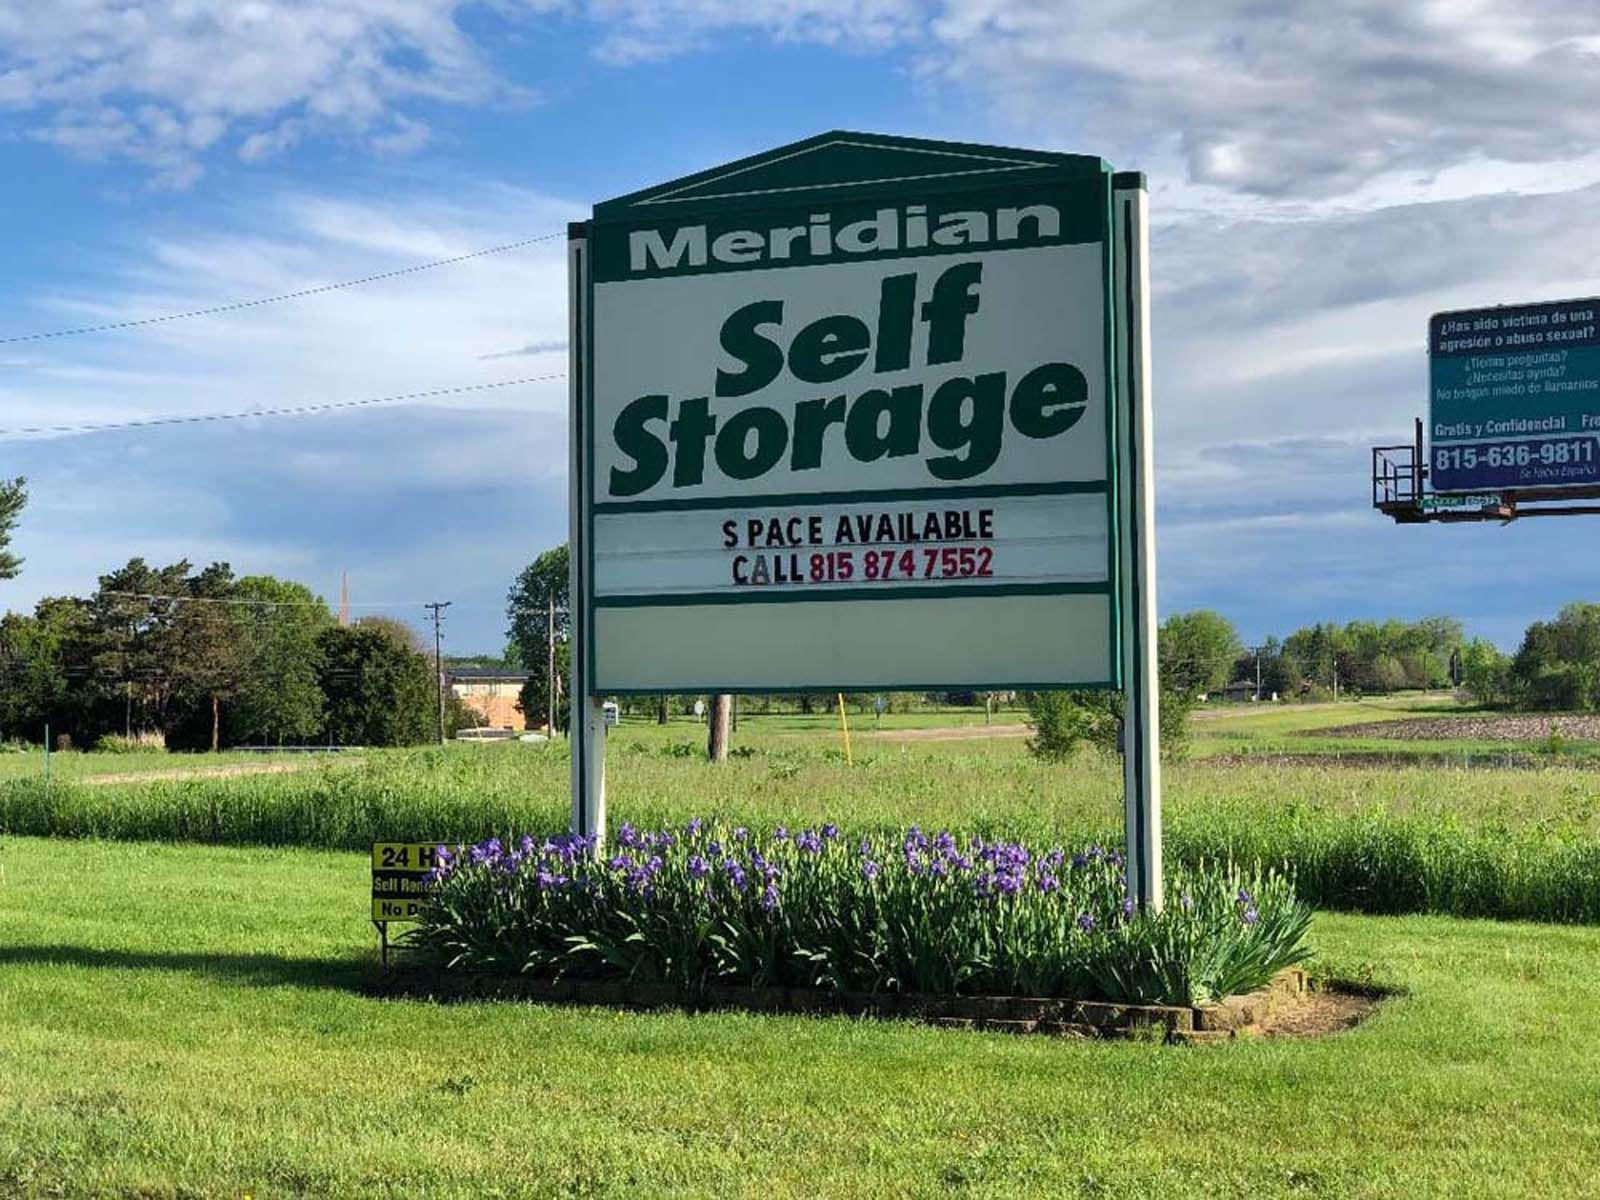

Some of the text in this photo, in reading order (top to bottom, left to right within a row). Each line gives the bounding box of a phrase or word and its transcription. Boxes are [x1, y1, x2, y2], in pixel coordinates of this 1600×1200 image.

[629, 203, 1061, 272] Meridian
[715, 261, 982, 398] Self
[1474, 317, 1499, 331] sido
[1551, 311, 1567, 323] de
[1570, 309, 1593, 321] una
[1495, 336, 1503, 346] o
[1506, 332, 1543, 345] abuso
[1546, 325, 1595, 342] sexual?
[608, 362, 1089, 498] Storage
[1434, 416, 1566, 437] Gratis y Confidencial
[1435, 441, 1593, 470] 815-636-9811
[835, 510, 993, 543] AVAILABLE
[733, 547, 993, 584] CALL 815 874 7552
[381, 847, 409, 867] 24
[382, 902, 401, 916] No
